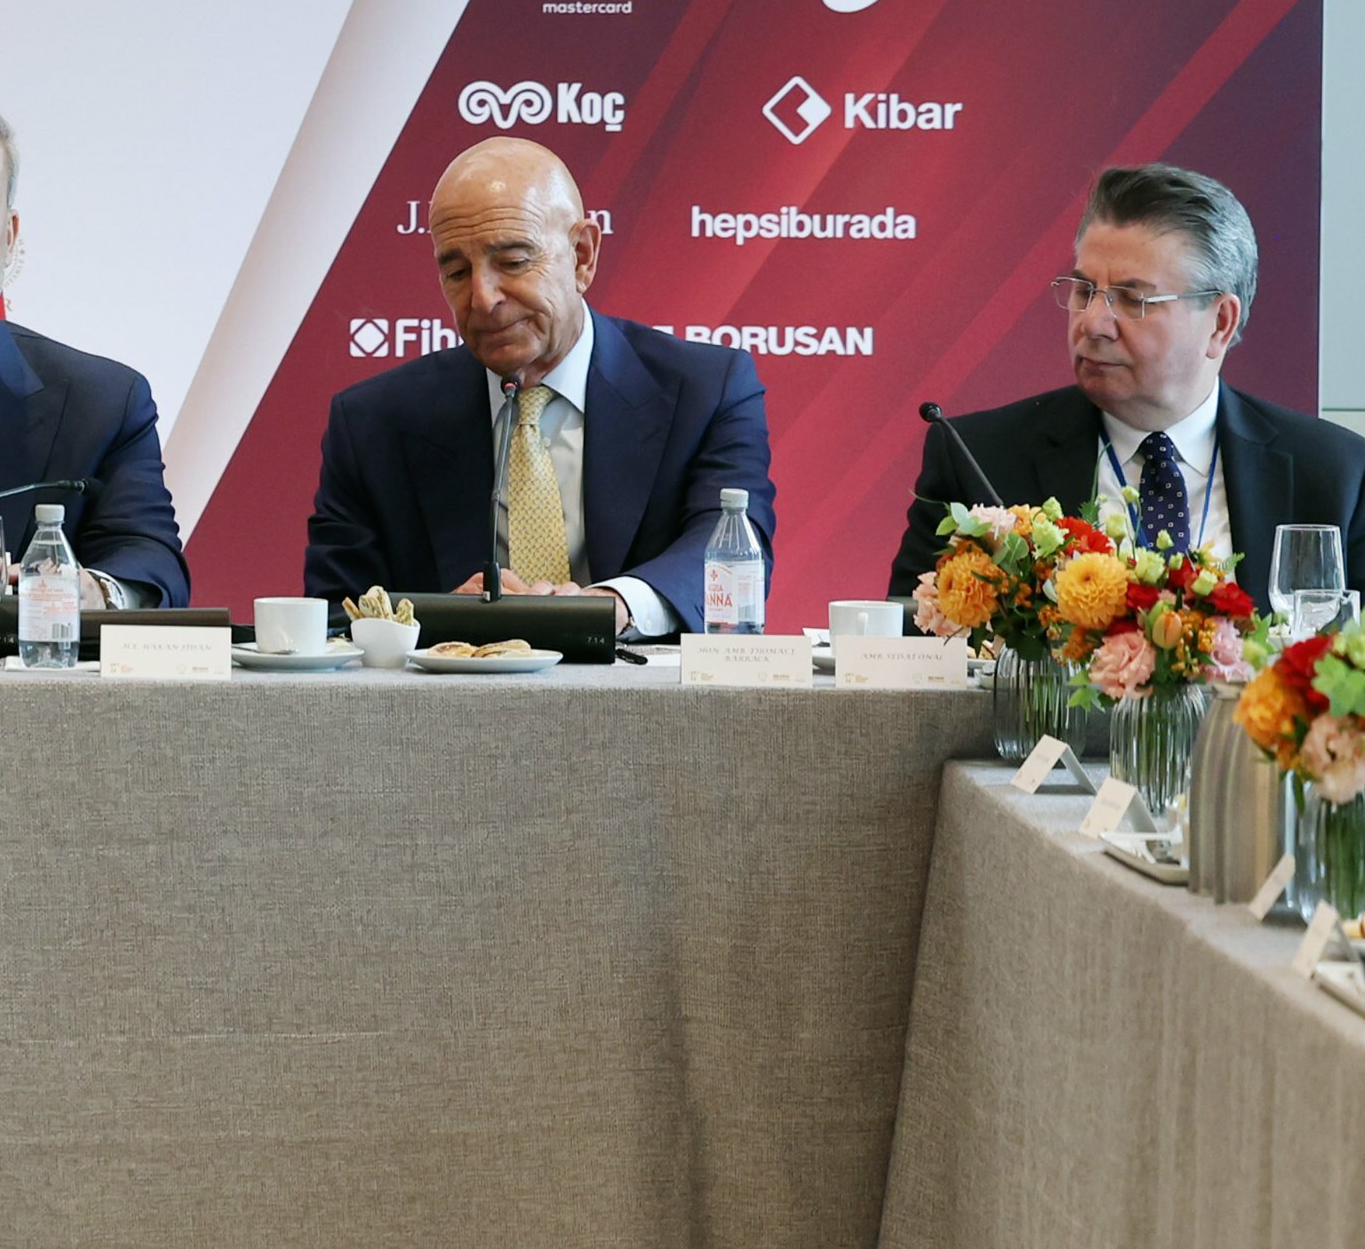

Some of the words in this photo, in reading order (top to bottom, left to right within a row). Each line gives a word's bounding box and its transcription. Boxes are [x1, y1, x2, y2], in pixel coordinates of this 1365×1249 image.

[543, 1, 632, 13] mastercard
[558, 83, 624, 131] Koç
[845, 93, 962, 129] Kibar
[692, 206, 915, 245] hepsiburada
[395, 318, 464, 358] Fib
[684, 325, 874, 356] BORUSAN
